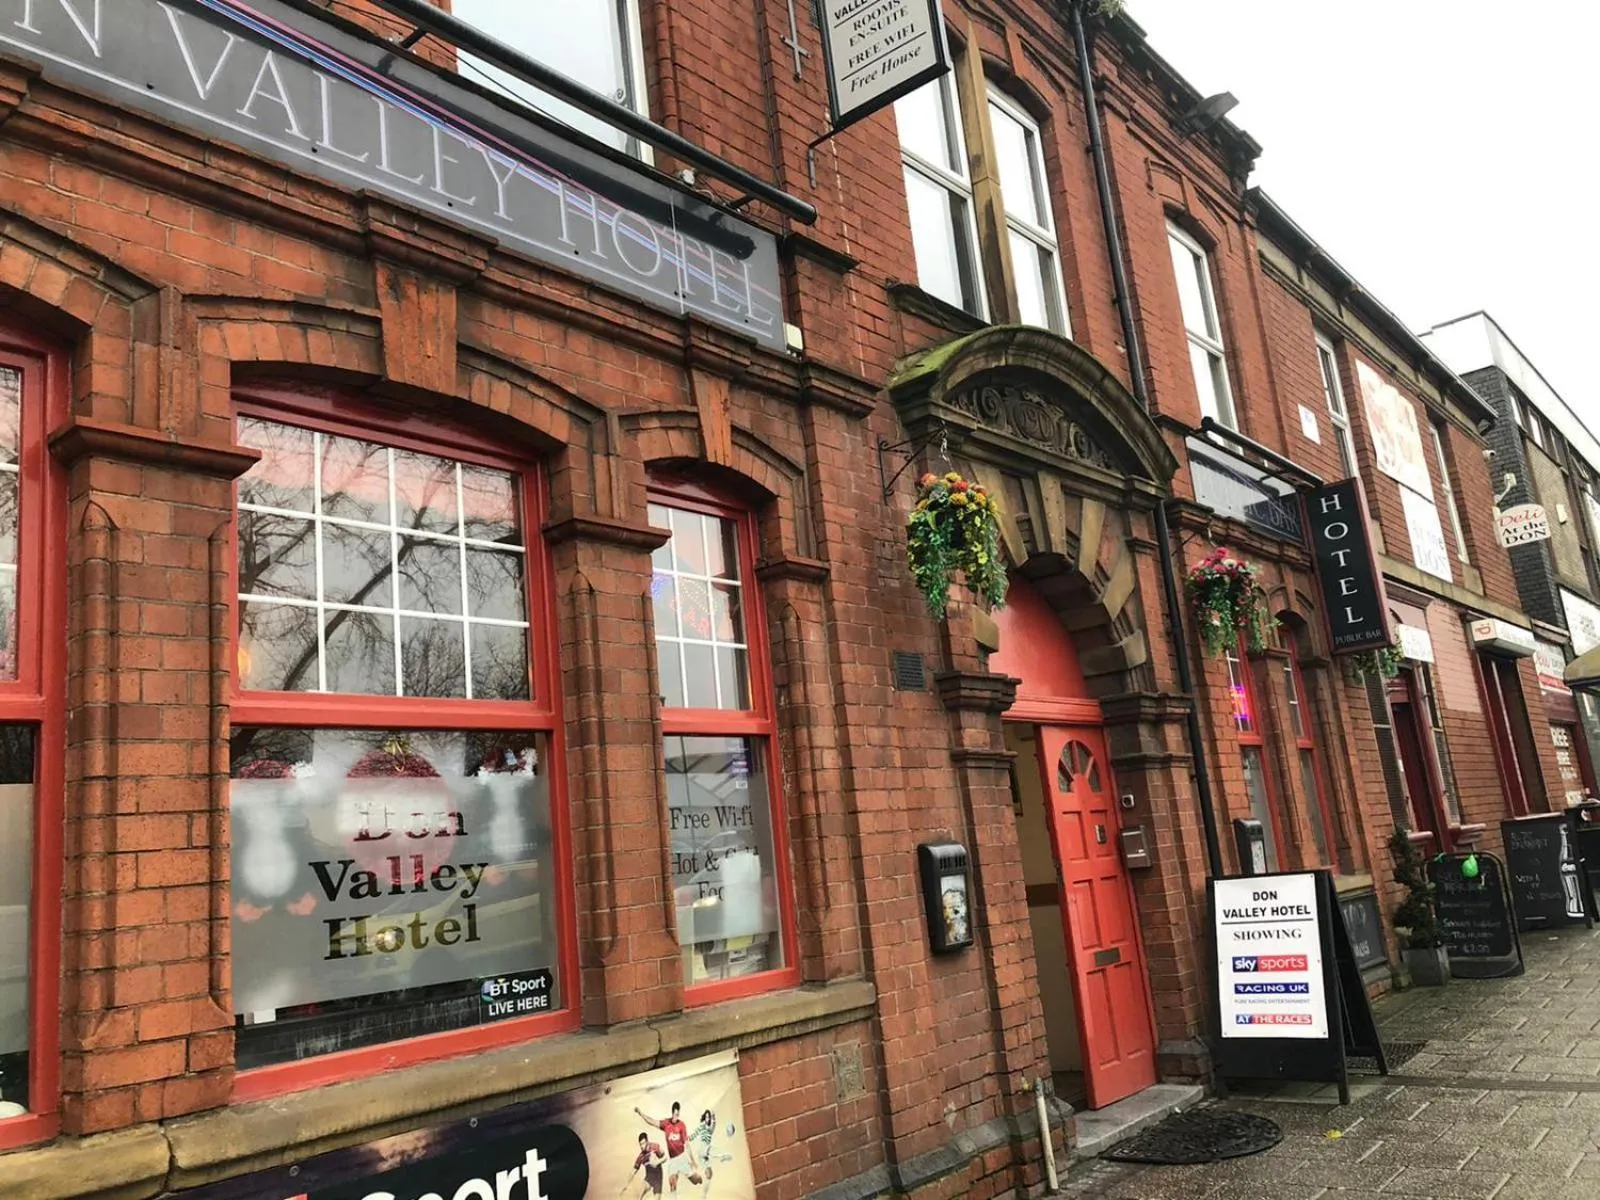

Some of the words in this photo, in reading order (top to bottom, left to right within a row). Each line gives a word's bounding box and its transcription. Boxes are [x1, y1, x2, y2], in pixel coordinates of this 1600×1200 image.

[849, 5, 909, 47] EN-SUITE
[853, 0, 902, 31] ROOMS
[848, 43, 881, 68] FREE
[884, 23, 915, 46] WIFI
[850, 70, 878, 92] Free
[881, 45, 921, 75] House
[156, 0, 527, 222] VALLEY
[552, 177, 775, 327] HOTEL
[1499, 509, 1542, 527] Deli
[1505, 529, 1547, 544] DON
[1320, 493, 1364, 624] HOTEL
[1334, 633, 1363, 645] PUBLIC
[1365, 629, 1382, 640] BAR
[668, 806, 710, 831] Free
[714, 805, 755, 828] Wi-fi
[704, 848, 720, 872] &
[308, 853, 489, 903] Valley
[1252, 890, 1278, 901] DON
[1223, 906, 1267, 919] VALLEY
[1271, 904, 1311, 916] HOTEL
[322, 903, 482, 961] Hotel
[1233, 928, 1302, 941] SHOWING
[1234, 957, 1256, 972] sky
[1260, 956, 1305, 971] sports
[490, 981, 510, 997] BT
[511, 976, 546, 994] Sport
[1236, 984, 1285, 993] RACING
[1289, 983, 1307, 992] UK
[488, 1000, 514, 1016] LIVE
[516, 995, 548, 1011] HERE
[1237, 1014, 1251, 1024] AT
[1254, 1014, 1274, 1024] THE
[1275, 1014, 1312, 1024] RACES
